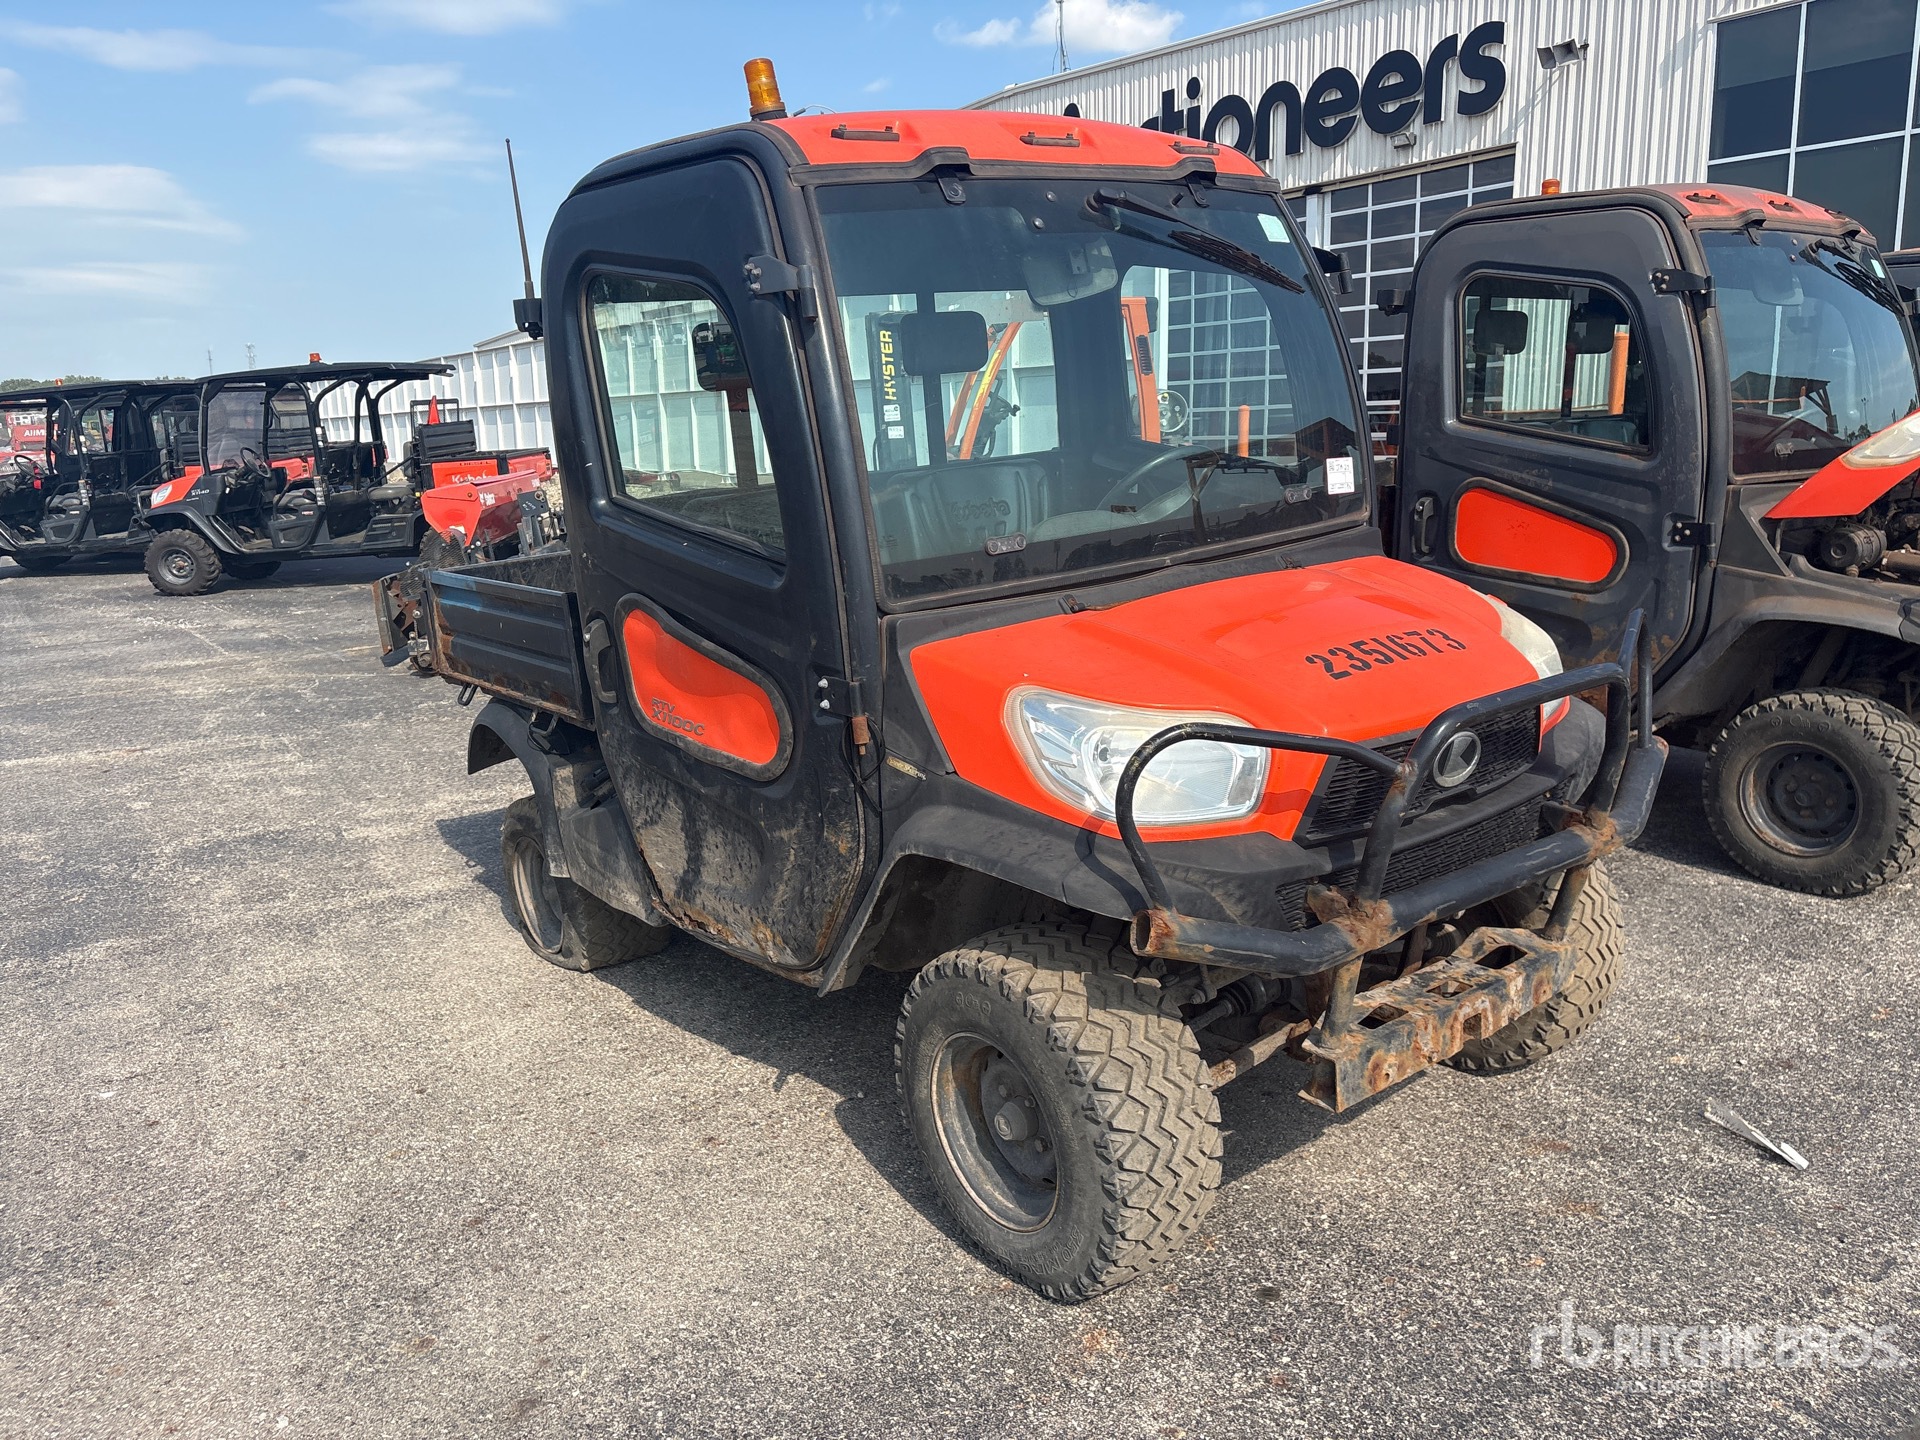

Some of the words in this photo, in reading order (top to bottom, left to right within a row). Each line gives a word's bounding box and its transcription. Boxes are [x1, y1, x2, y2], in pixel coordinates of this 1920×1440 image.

[1064, 20, 1506, 161] tioneers
[880, 330, 898, 400] HYSTER
[452, 469, 493, 484] Kubot
[1304, 628, 1468, 681] 2351673
[652, 697, 676, 713] RTV
[652, 707, 705, 736] X1100C
